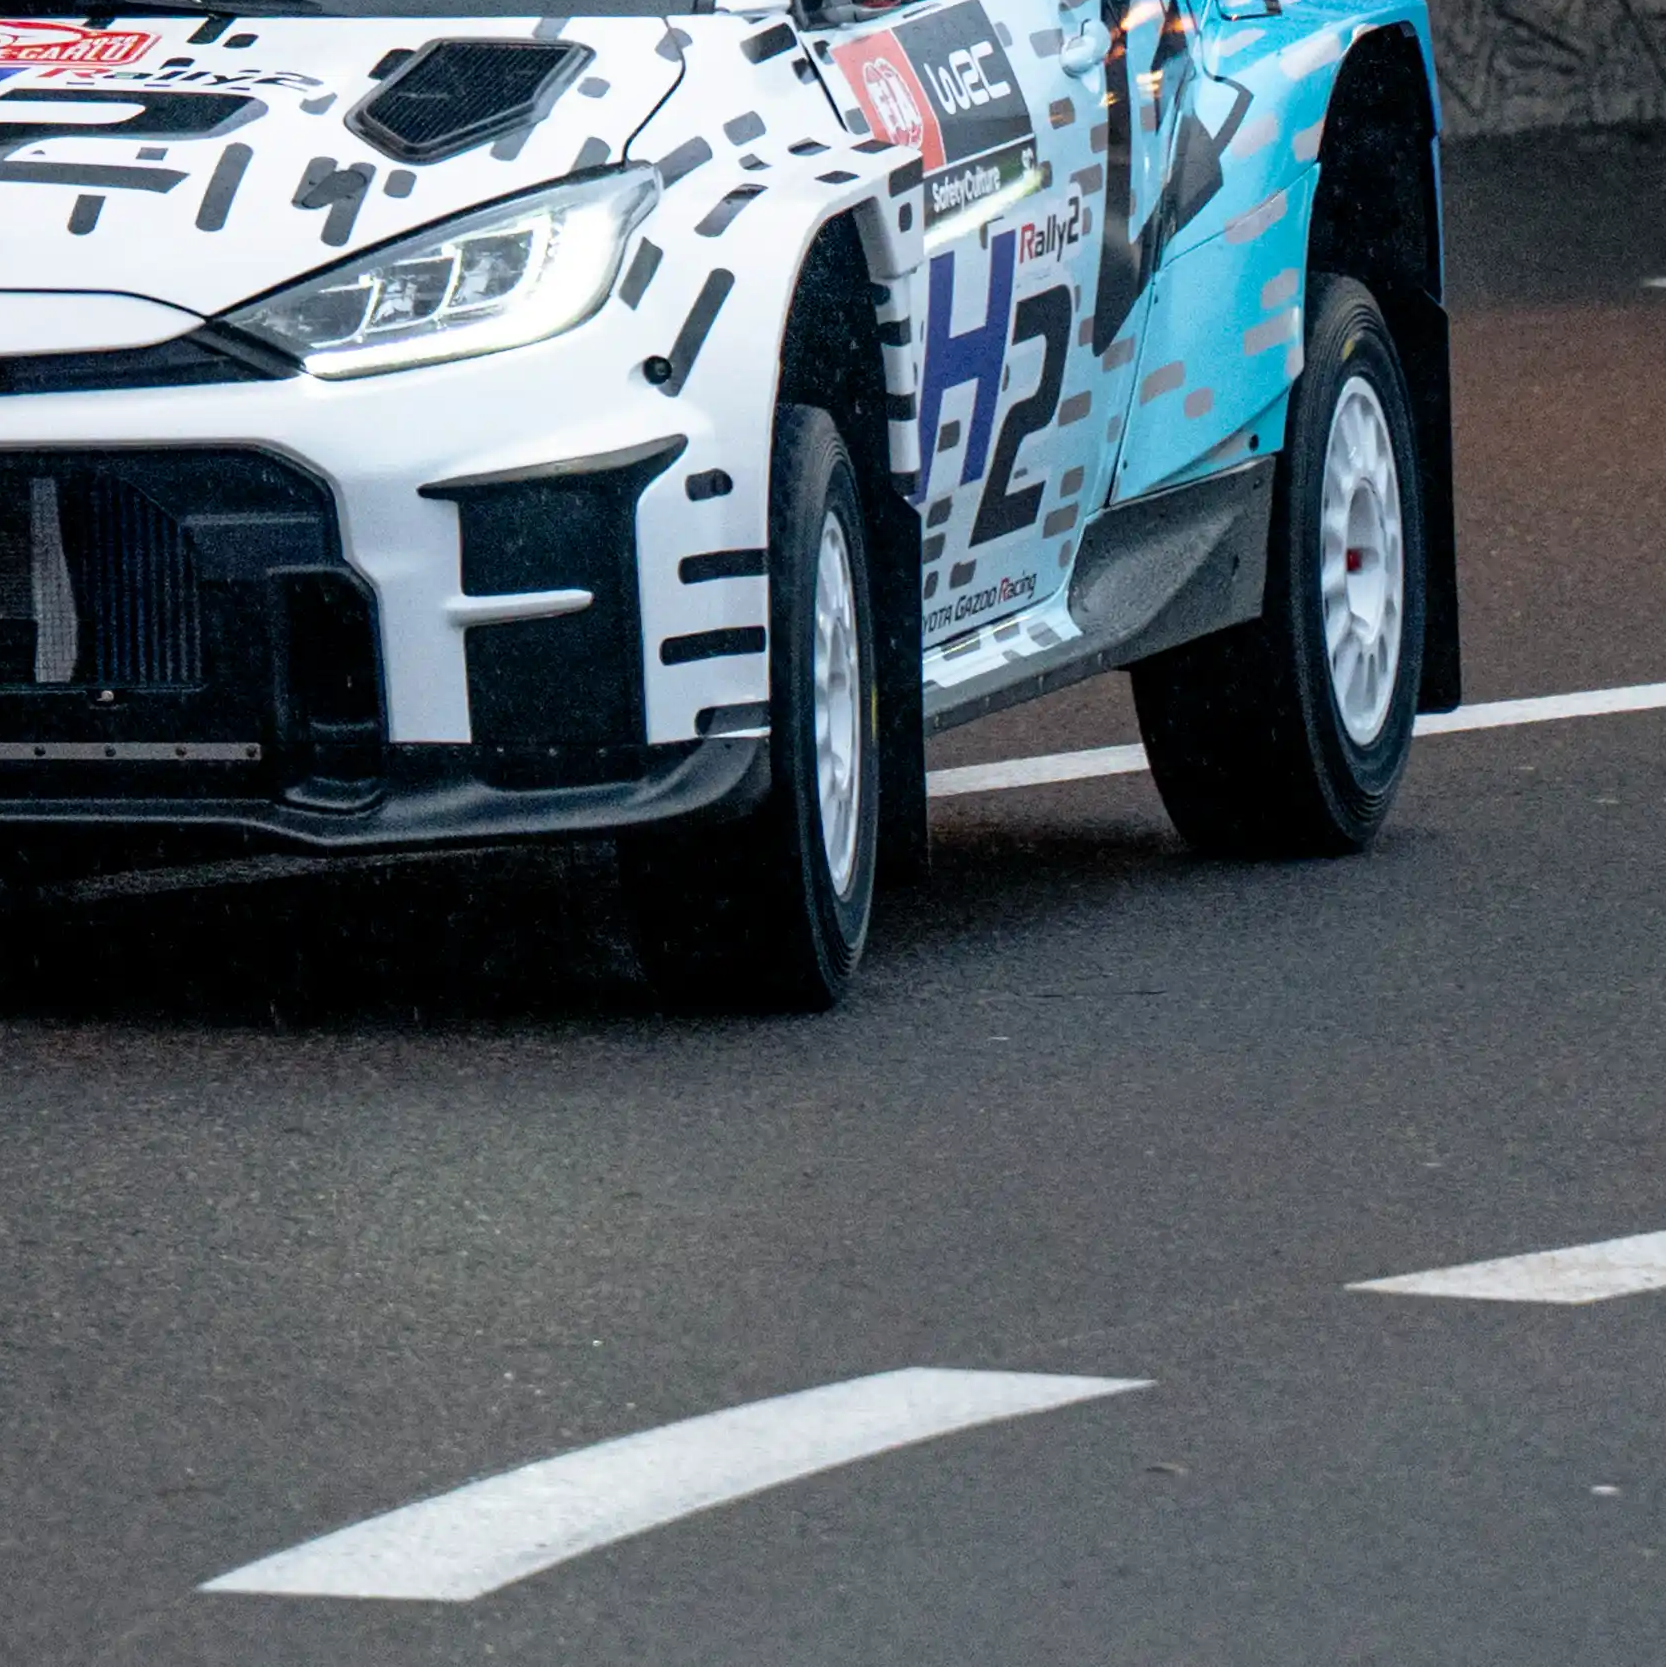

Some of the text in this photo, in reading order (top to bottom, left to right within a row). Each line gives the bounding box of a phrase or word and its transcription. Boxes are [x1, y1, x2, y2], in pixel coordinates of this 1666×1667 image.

[36, 67, 324, 92] Rally2
[923, 40, 1012, 116] WRC
[931, 165, 1002, 213] SafetyCulture
[1018, 195, 1081, 264] Rally2
[906, 229, 1073, 549] H2
[954, 586, 998, 622] GAZOO
[997, 570, 1038, 605] Racing
